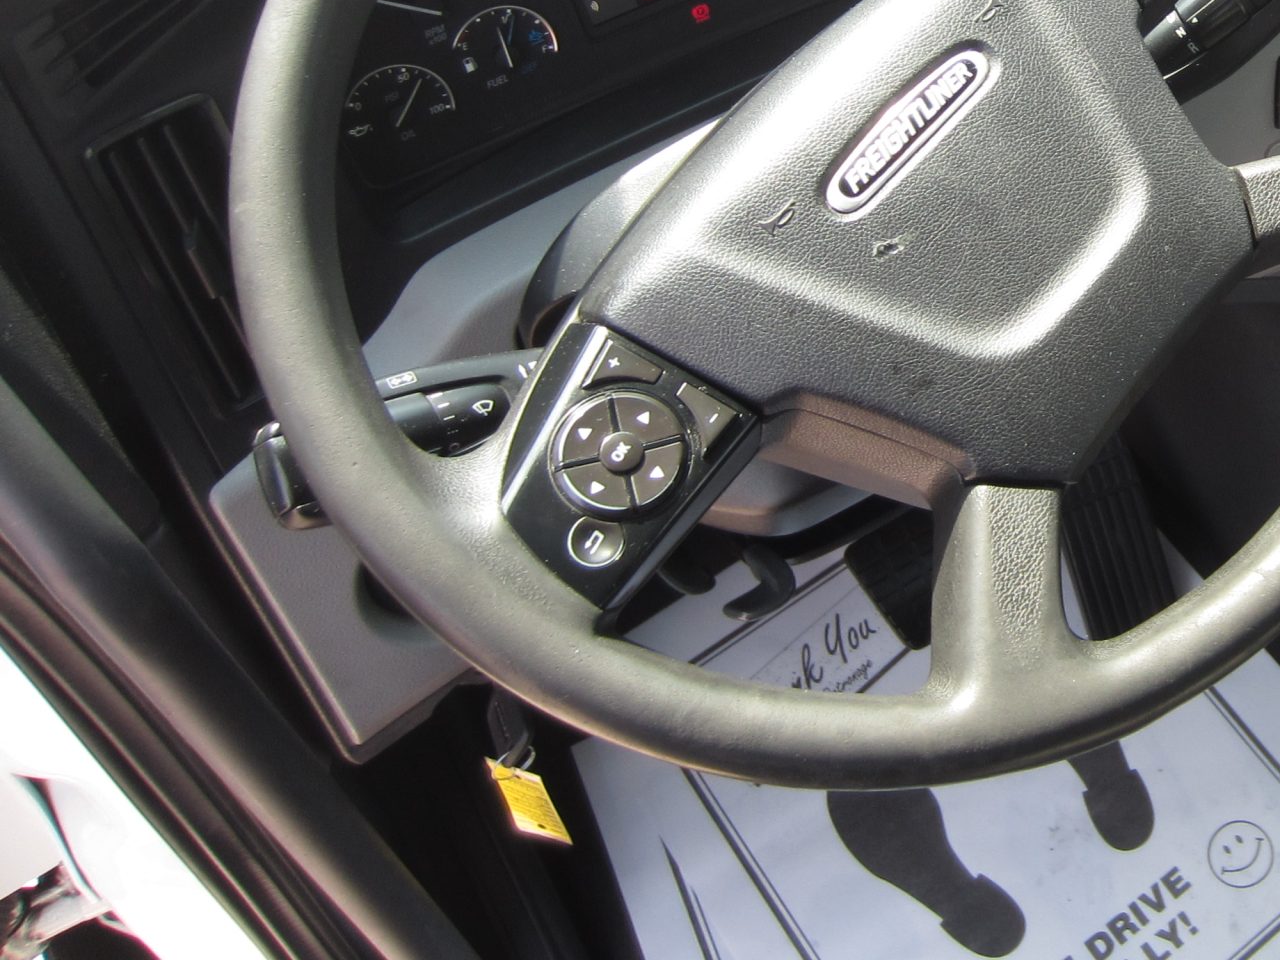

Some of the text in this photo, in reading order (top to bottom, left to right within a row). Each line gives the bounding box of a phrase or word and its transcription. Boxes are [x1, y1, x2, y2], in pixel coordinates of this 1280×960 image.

[487, 74, 509, 88] FUEL
[429, 103, 445, 115] 100
[844, 62, 974, 194] FREIGHTLINER
[610, 440, 631, 463] OK
[824, 612, 876, 663] You
[1083, 865, 1193, 960] DRIVE
